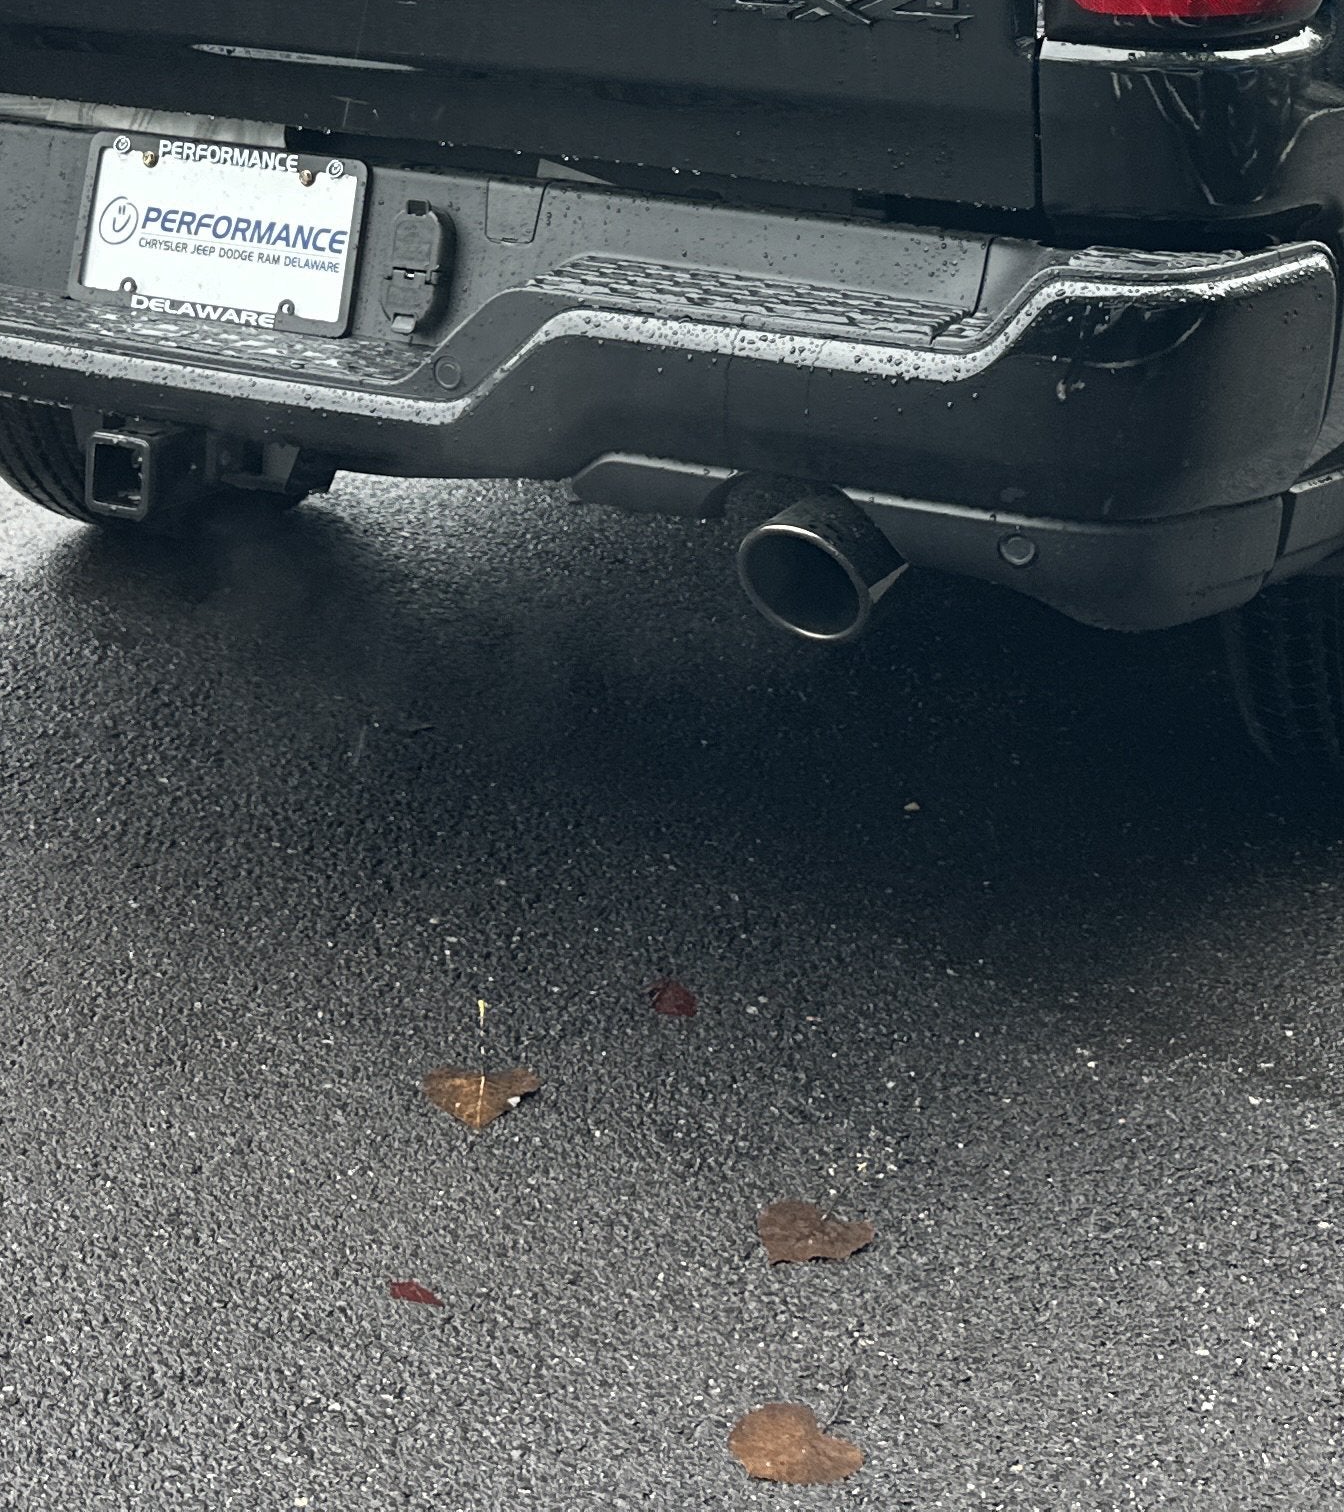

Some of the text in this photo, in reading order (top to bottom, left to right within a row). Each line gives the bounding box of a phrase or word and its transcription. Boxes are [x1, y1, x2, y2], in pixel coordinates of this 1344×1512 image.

[158, 139, 299, 173] PERFORMANCE
[141, 206, 348, 254] PERFORMANCE
[138, 236, 341, 274] CHRYSLER JEEP DODGE RAM DELAWARE
[130, 294, 276, 329] DELAWARE
